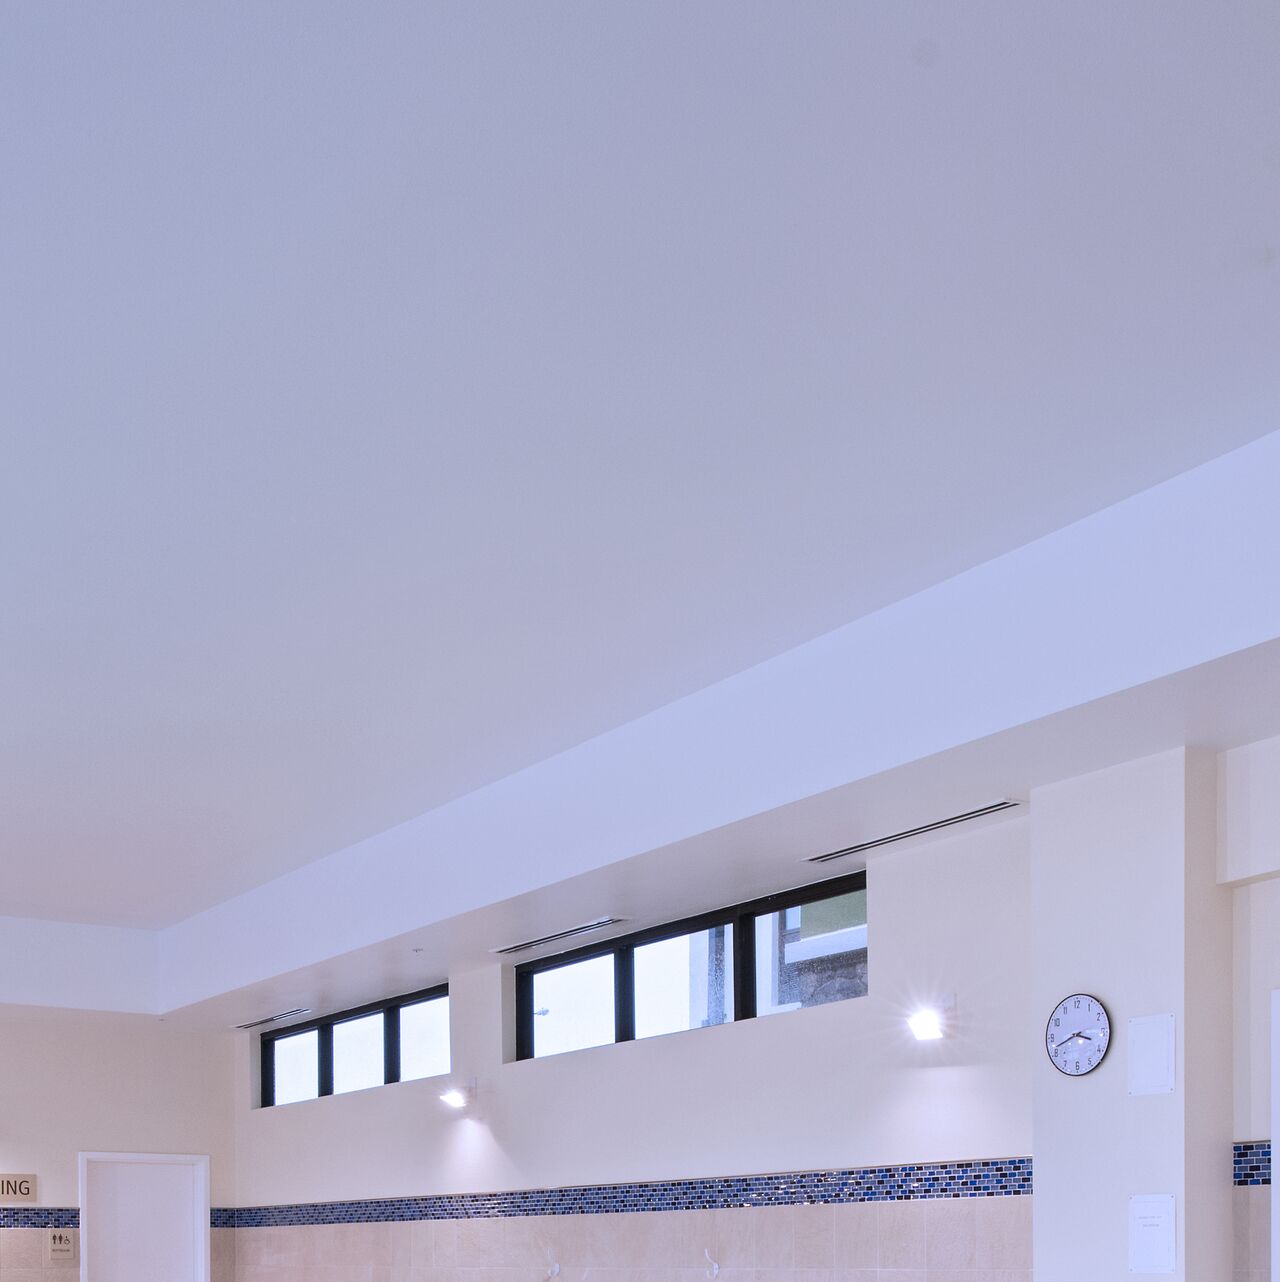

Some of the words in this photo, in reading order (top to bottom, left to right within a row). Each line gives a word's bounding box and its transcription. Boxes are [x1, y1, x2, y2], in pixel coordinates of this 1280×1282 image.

[1074, 1000, 1081, 1009] 12
[1088, 1004, 1091, 1012] 1
[1063, 1007, 1068, 1015] 11
[1096, 1012, 1101, 1021] 2
[1050, 1033, 1055, 1042] 9
[1054, 1048, 1059, 1057] 8
[1076, 1061, 1080, 1070] 6
